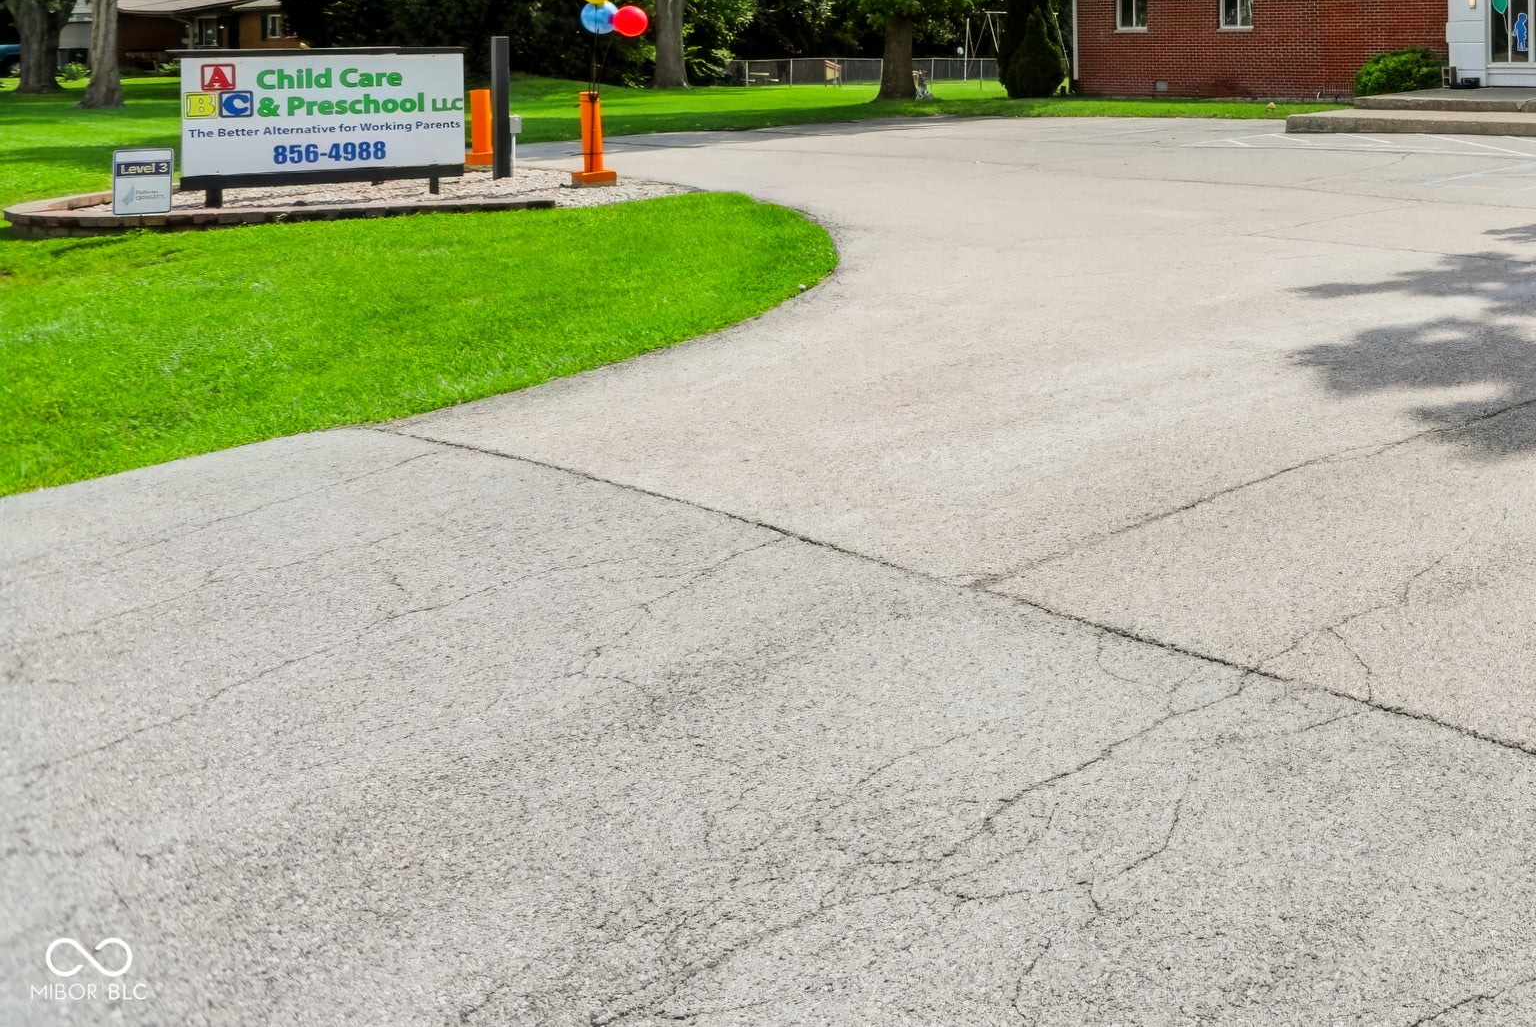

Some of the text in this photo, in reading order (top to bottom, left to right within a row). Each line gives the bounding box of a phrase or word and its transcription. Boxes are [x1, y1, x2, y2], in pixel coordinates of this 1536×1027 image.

[203, 66, 234, 88] A
[256, 68, 403, 90] Child Care
[257, 92, 463, 117] & Preschool LLC
[188, 120, 461, 138] The Better Alternative for Working Parents
[273, 141, 387, 165] 856-4988
[121, 163, 168, 174] Level 3
